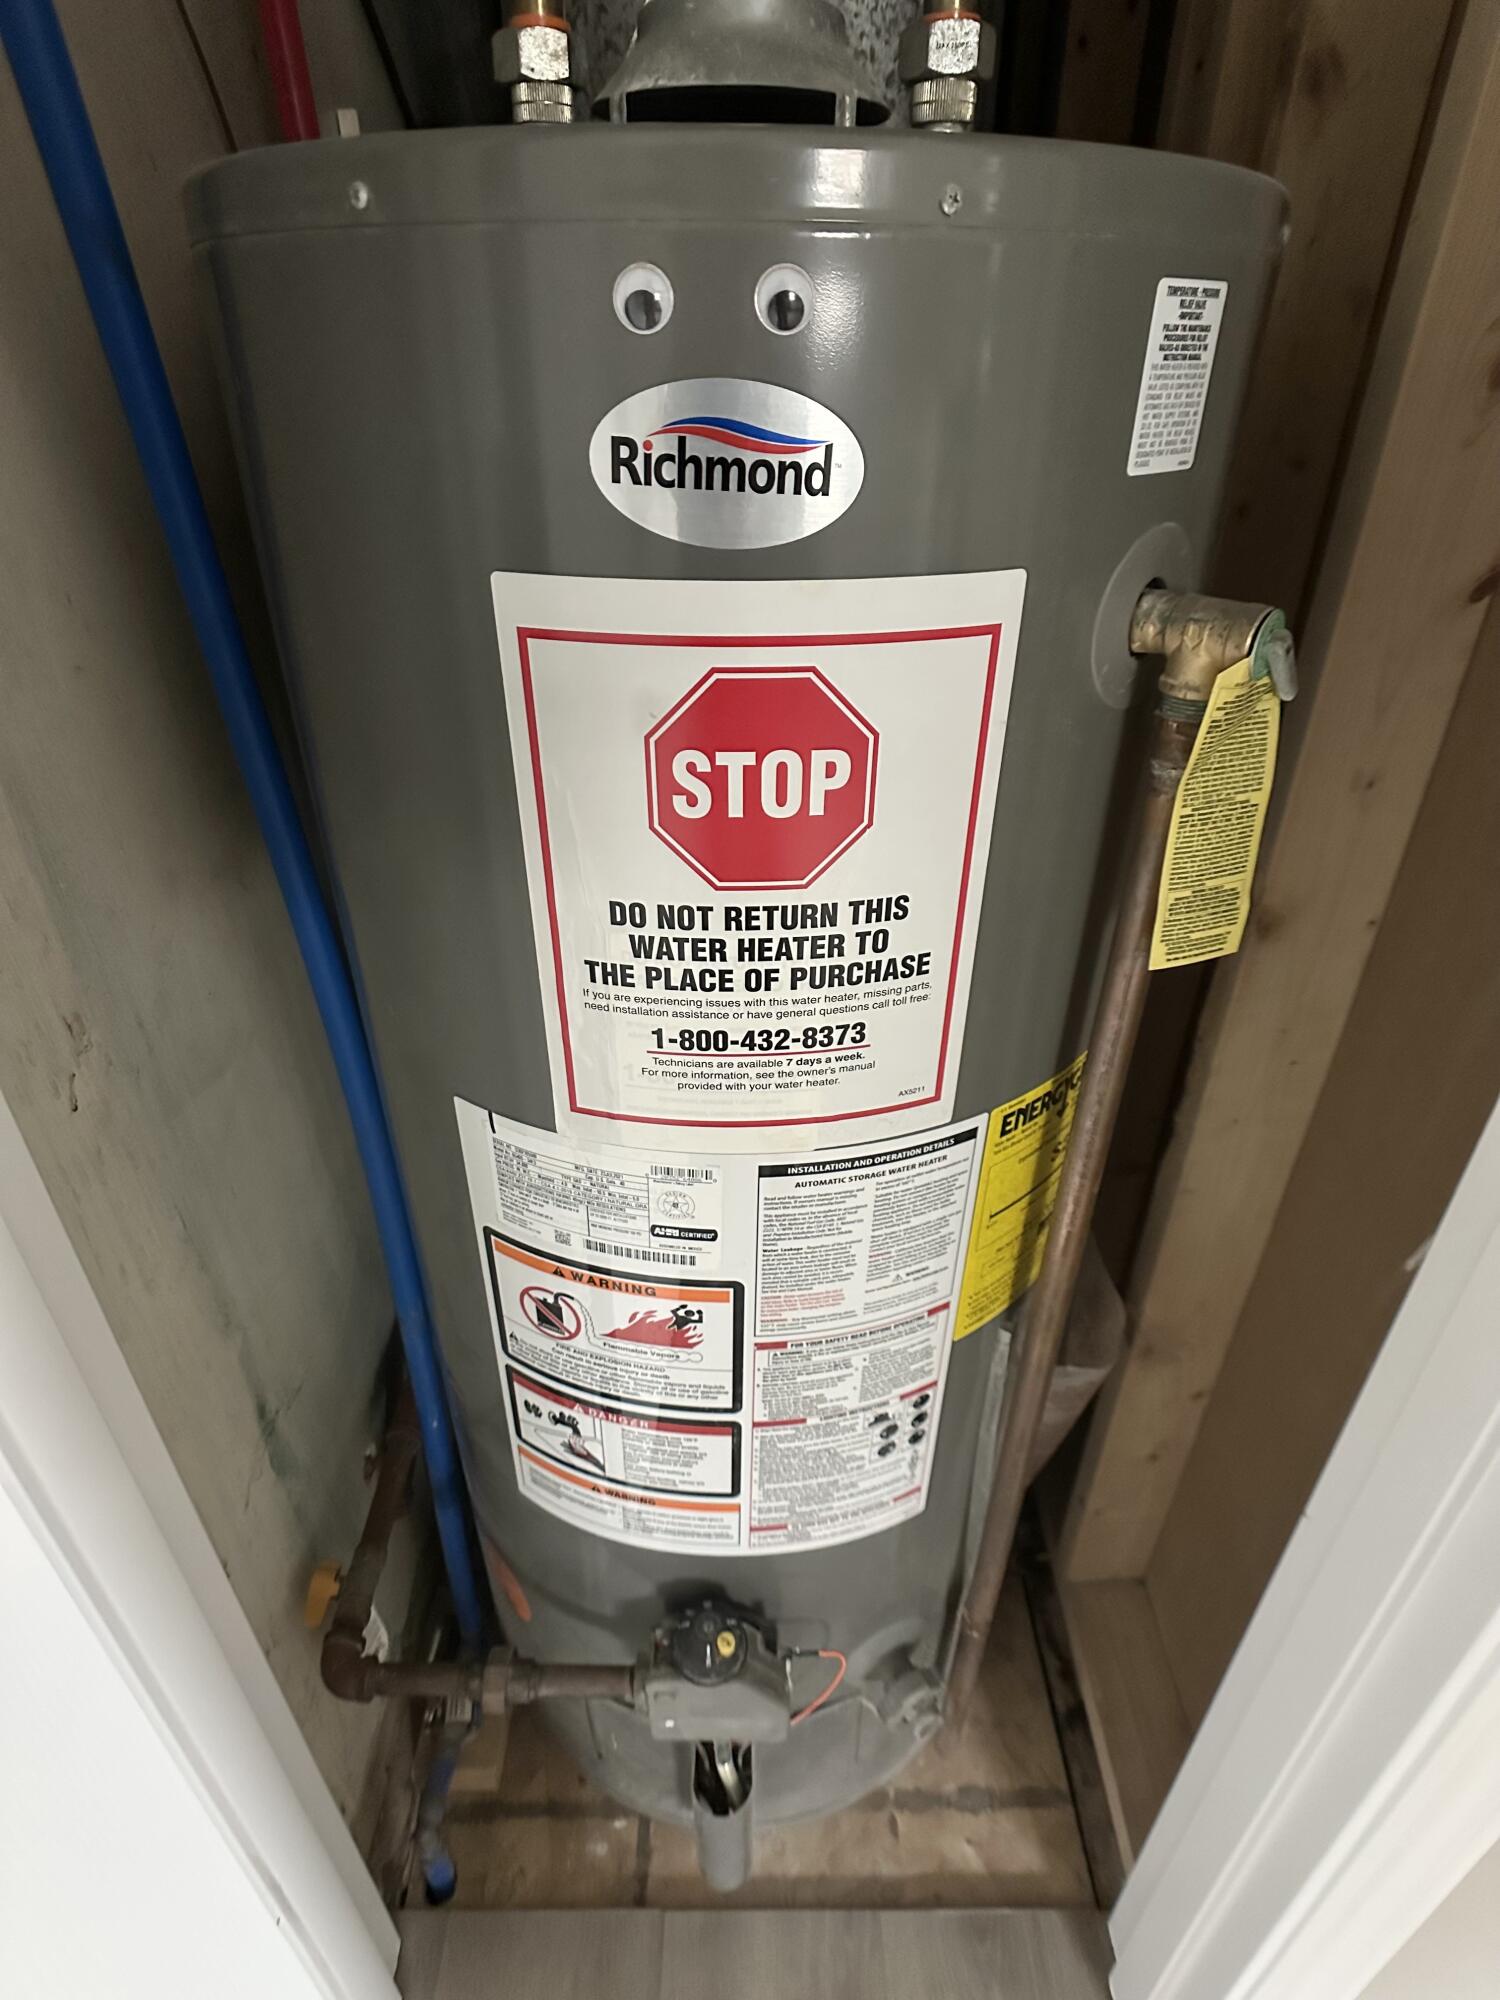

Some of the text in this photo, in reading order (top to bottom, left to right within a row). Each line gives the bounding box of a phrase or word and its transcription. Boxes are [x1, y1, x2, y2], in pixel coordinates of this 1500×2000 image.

[611, 435, 834, 496] Richmond
[672, 749, 851, 818] STOP
[609, 895, 910, 931] DO NOT RETURN THIS
[628, 929, 889, 962] WATER HEATER TO
[584, 952, 931, 992] THE PLACE OF PURCHASE
[583, 988, 594, 997] If
[592, 990, 610, 1000] you
[614, 993, 630, 1002] are
[635, 995, 702, 1008] experiencing
[705, 997, 740, 1007] issues
[744, 998, 765, 1007] with
[769, 997, 789, 1006] this
[792, 996, 821, 1005] water
[863, 987, 902, 999] missing
[905, 981, 932, 994] parts,
[584, 1001, 609, 1011] need
[613, 1004, 668, 1017] installation
[672, 1010, 729, 1019] assistance
[747, 1010, 773, 1019] have
[776, 1008, 816, 1020] general
[820, 1004, 869, 1017] questions
[872, 998, 889, 1009] call
[893, 995, 907, 1007] toll
[651, 1022, 866, 1051] 1-800-432-8373
[642, 1068, 659, 1077] For
[661, 1070, 688, 1078] more
[691, 1070, 752, 1080] information,
[755, 1070, 774, 1079] see
[778, 1069, 794, 1078] the
[839, 1061, 875, 1073] manual
[653, 1057, 713, 1068] Technicians
[737, 1058, 783, 1068] available
[786, 1058, 793, 1066] 7
[796, 1056, 822, 1067] days
[835, 1052, 865, 1062] week.
[678, 1077, 840, 1092] provided with your water heater.
[898, 1086, 925, 1096] AX5211
[788, 1138, 955, 1174] INSTALLATION AND OPERATION DETAILS
[795, 1155, 948, 1188] AUTOMATIC STORAGE WATER HEATER
[572, 1271, 656, 1297] WARNING
[603, 1342, 680, 1359] Flammable Vapors
[588, 1407, 649, 1429] DANGER
[605, 1488, 656, 1505] WARNING
